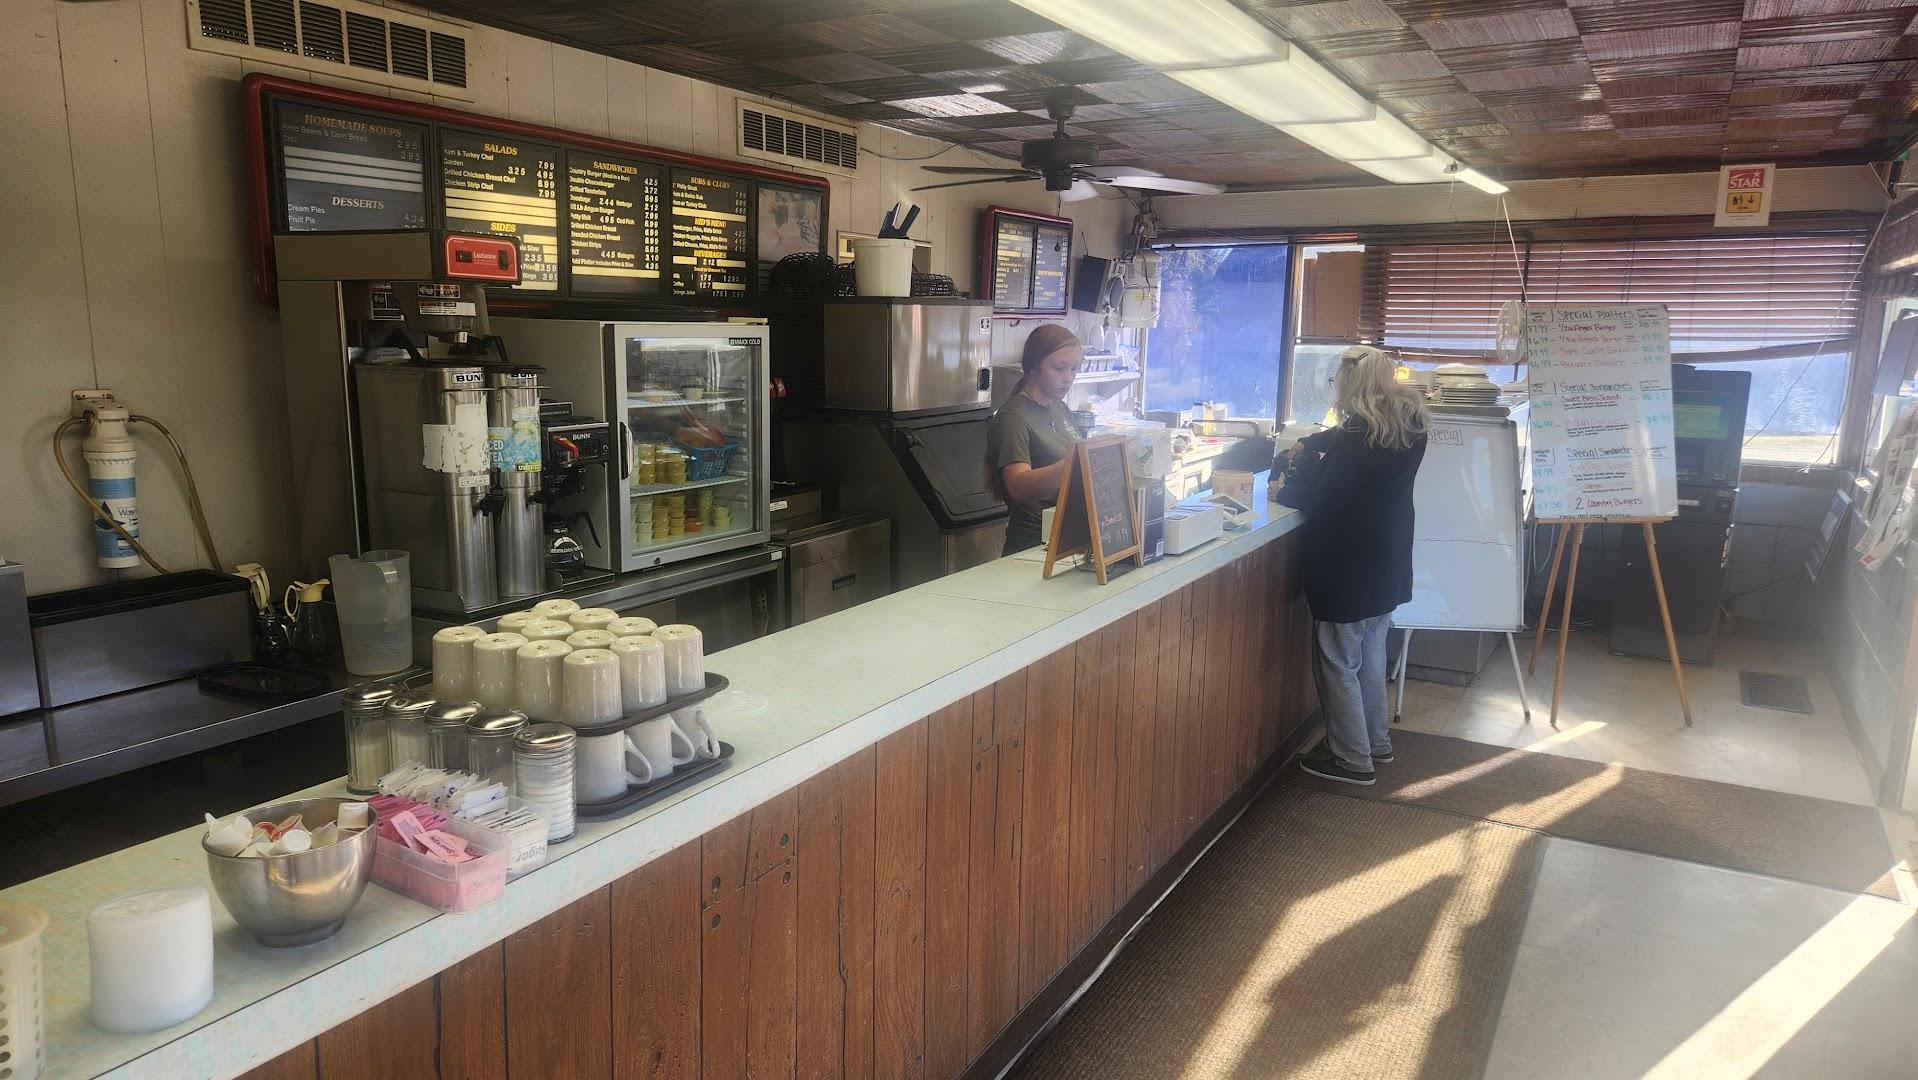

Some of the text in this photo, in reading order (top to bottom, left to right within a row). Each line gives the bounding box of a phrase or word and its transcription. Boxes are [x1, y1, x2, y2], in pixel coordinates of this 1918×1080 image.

[305, 114, 402, 140] HOMEMADE SOUPS
[484, 143, 518, 156] SALADS
[462, 151, 480, 160] Turkey
[593, 161, 638, 175] SANDWICHES
[463, 170, 485, 180] Chicken
[1728, 178, 1761, 190] STAR
[332, 196, 384, 209] DESSERTS
[287, 204, 310, 213] Cream
[491, 222, 517, 233] SIDES
[693, 250, 728, 259] BEVERAGES
[572, 432, 592, 441] BUNN
